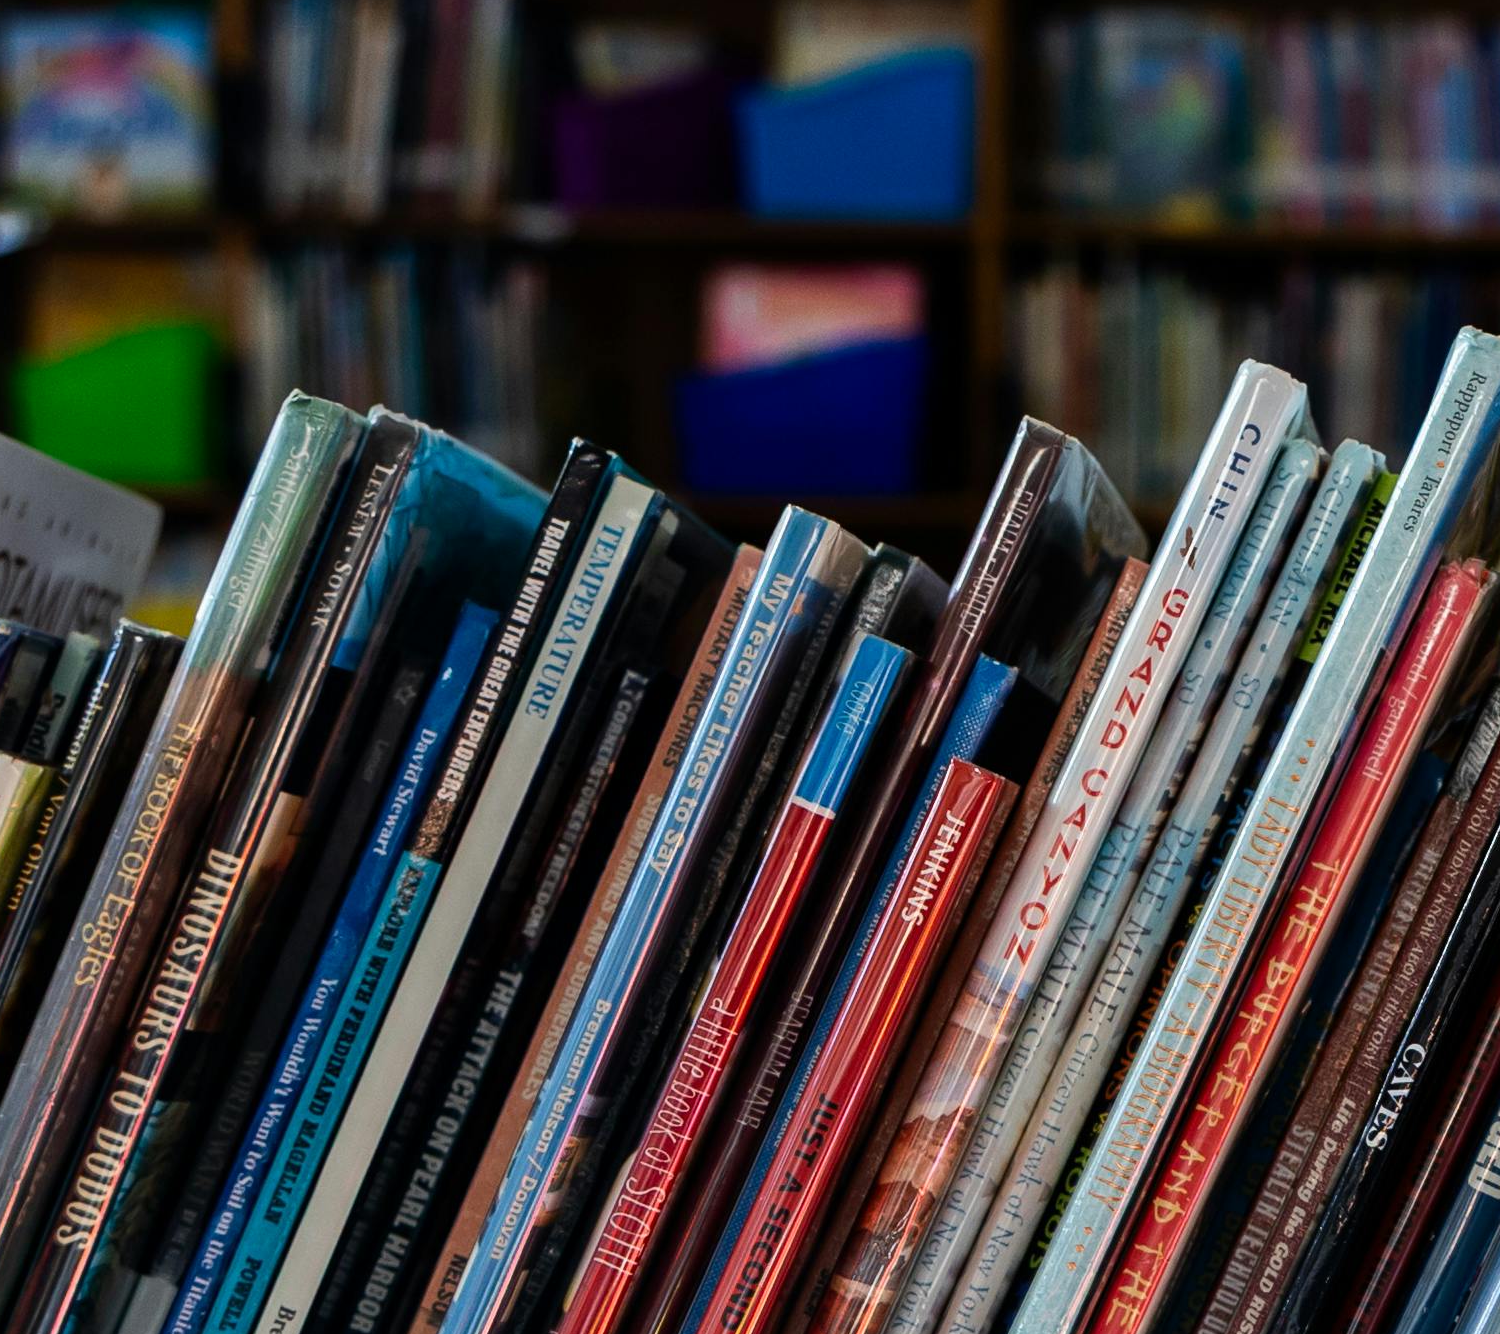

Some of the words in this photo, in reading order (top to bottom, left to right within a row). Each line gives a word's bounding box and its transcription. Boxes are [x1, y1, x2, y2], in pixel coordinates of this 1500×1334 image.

[1433, 368, 1488, 458] Rappaport
[1204, 421, 1263, 522] CHIN
[1399, 472, 1441, 535] Tavares
[528, 515, 569, 579] TRAVEL
[509, 575, 545, 625] WITH
[522, 519, 625, 721] TEMPERATURE
[757, 570, 793, 614] My
[495, 622, 525, 658] THE
[713, 614, 775, 720] Teacher
[1097, 584, 1189, 752] GRAND
[473, 654, 512, 712] GREAT
[400, 726, 437, 784] David
[435, 708, 490, 804] EXPLORERS
[683, 720, 731, 793] Likes
[370, 783, 414, 858] Stewart
[669, 793, 700, 827] to
[1236, 793, 1298, 877] LADY
[647, 826, 687, 878] Say
[898, 809, 967, 928] JENKINS
[1002, 764, 1109, 968] CANYON
[1275, 850, 1343, 950] THE
[128, 846, 242, 1060] DINOSAURS
[1180, 874, 1262, 1002] LIBERTY
[307, 974, 337, 1013] You
[707, 995, 740, 1019] a
[1161, 1011, 1200, 1044] A
[271, 1013, 321, 1099] Wouldn't
[532, 997, 611, 1155] Brennan-Nelson
[675, 1016, 737, 1086] little
[1189, 954, 1296, 1142] BURGER
[105, 1066, 153, 1119] TO
[250, 1098, 285, 1149] Want
[648, 1078, 711, 1150] book
[1085, 1041, 1187, 1215] BIOGRAPHY
[1325, 1095, 1357, 1135] Life
[1361, 1039, 1429, 1154] CAVES
[240, 1148, 264, 1172] to
[634, 1143, 683, 1182] of
[789, 1091, 840, 1168] JUST
[50, 1125, 130, 1254] DODOS
[224, 1171, 254, 1211] Sail
[775, 1170, 805, 1198] A
[1149, 1140, 1213, 1231] AND
[1294, 1135, 1339, 1204] During
[212, 1209, 238, 1238] on
[487, 1174, 537, 1263] Donovan
[591, 1175, 669, 1278] SLOTH
[1278, 1203, 1308, 1240] the
[198, 1238, 226, 1272] the
[716, 1202, 791, 1334] SECOND
[1103, 1234, 1171, 1333] THE
[1253, 1239, 1292, 1295] GOLD
